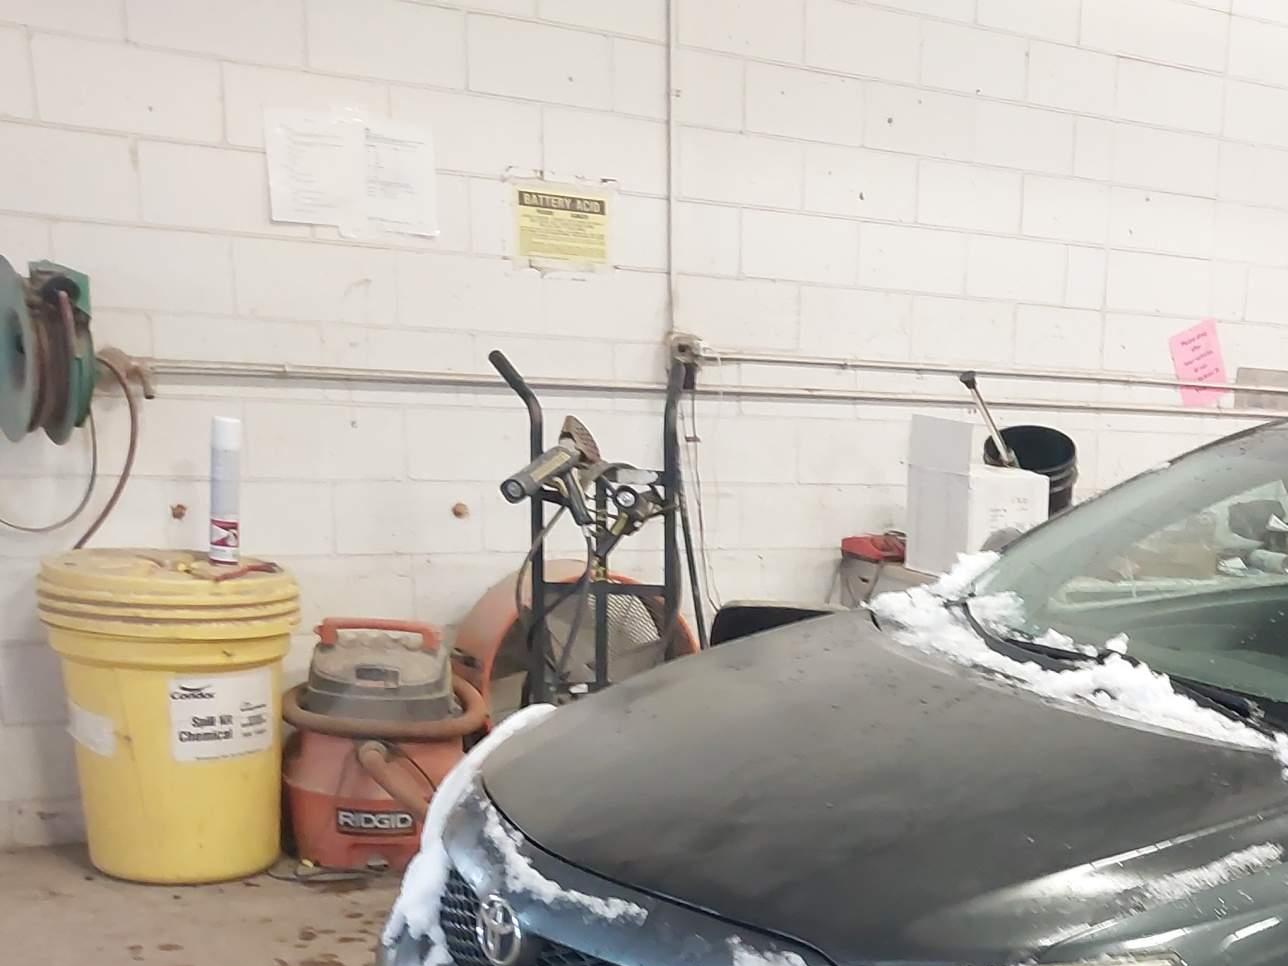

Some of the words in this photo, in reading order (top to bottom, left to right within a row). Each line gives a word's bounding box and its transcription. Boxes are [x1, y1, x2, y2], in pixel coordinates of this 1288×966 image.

[522, 192, 572, 210] BATTERY
[576, 200, 601, 213] ACID
[179, 729, 233, 741] Chemical
[338, 811, 413, 829] RIDGID
